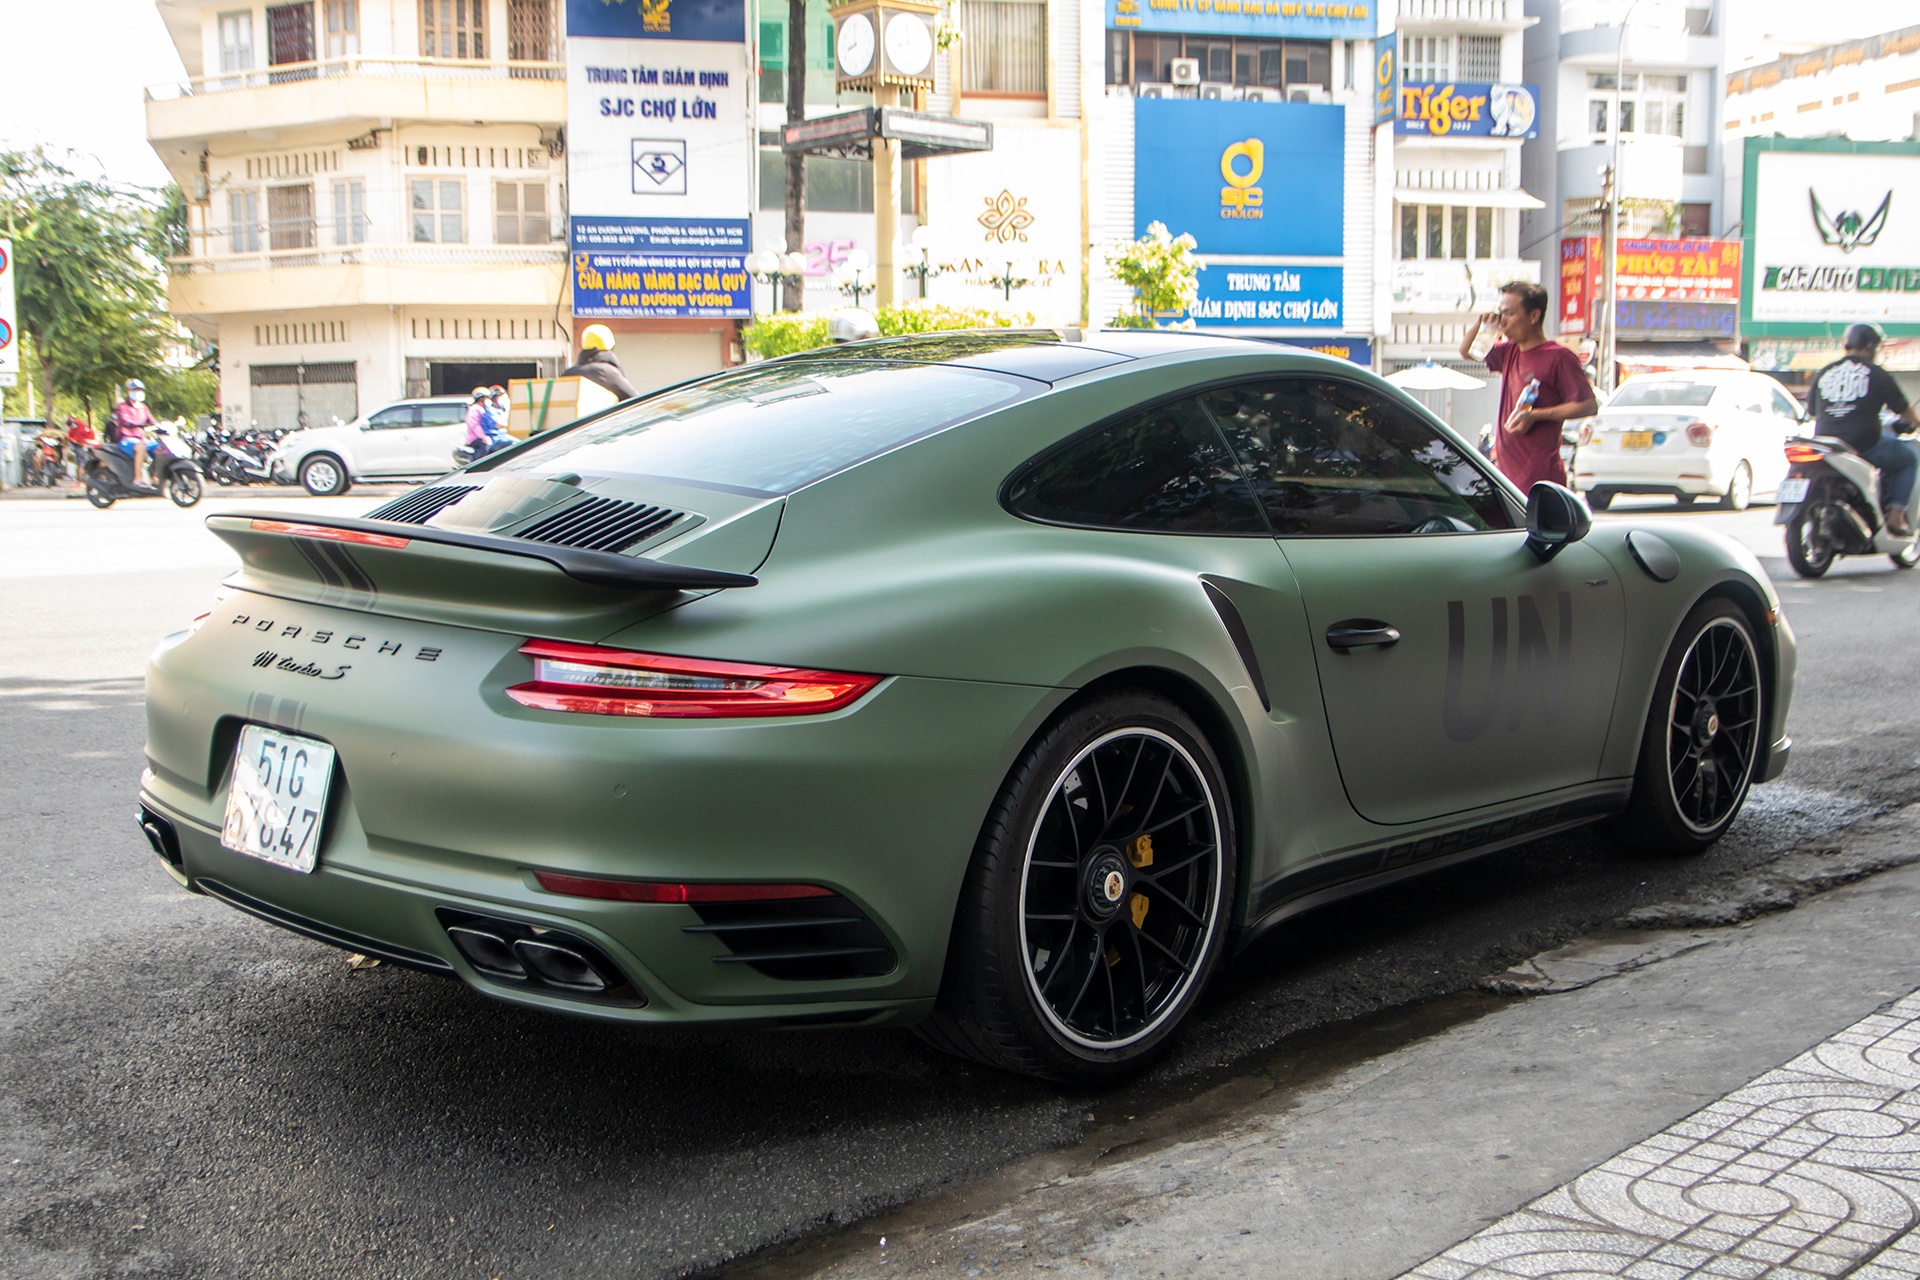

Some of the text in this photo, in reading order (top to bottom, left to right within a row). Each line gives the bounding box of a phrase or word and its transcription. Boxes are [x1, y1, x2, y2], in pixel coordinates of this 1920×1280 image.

[586, 65, 729, 90] TRUNG TÂM GIÁM ĐỊNH
[600, 95, 717, 122] SJC CHỢ LỚN
[1402, 84, 1486, 135] Tiger
[1220, 207, 1263, 219] CHOLON
[1617, 251, 1675, 275] PHÚC
[1679, 252, 1719, 276] TÀI
[606, 268, 641, 290] HÀNG
[642, 268, 676, 291] VÀNG
[677, 272, 702, 294] BẠC
[703, 269, 720, 291] ĐÁ
[721, 269, 747, 292] QUÝ
[1227, 270, 1301, 292] TRUNG TÂM
[603, 291, 733, 307] 12 AN DƯƠNG VƯƠNG
[1188, 297, 1338, 322] GIÁM ĐỊNH SJC CHỢ LỚN
[232, 614, 442, 662] PORSCHE
[276, 655, 322, 677] turbo
[319, 664, 352, 680] S
[258, 740, 308, 798] 51G
